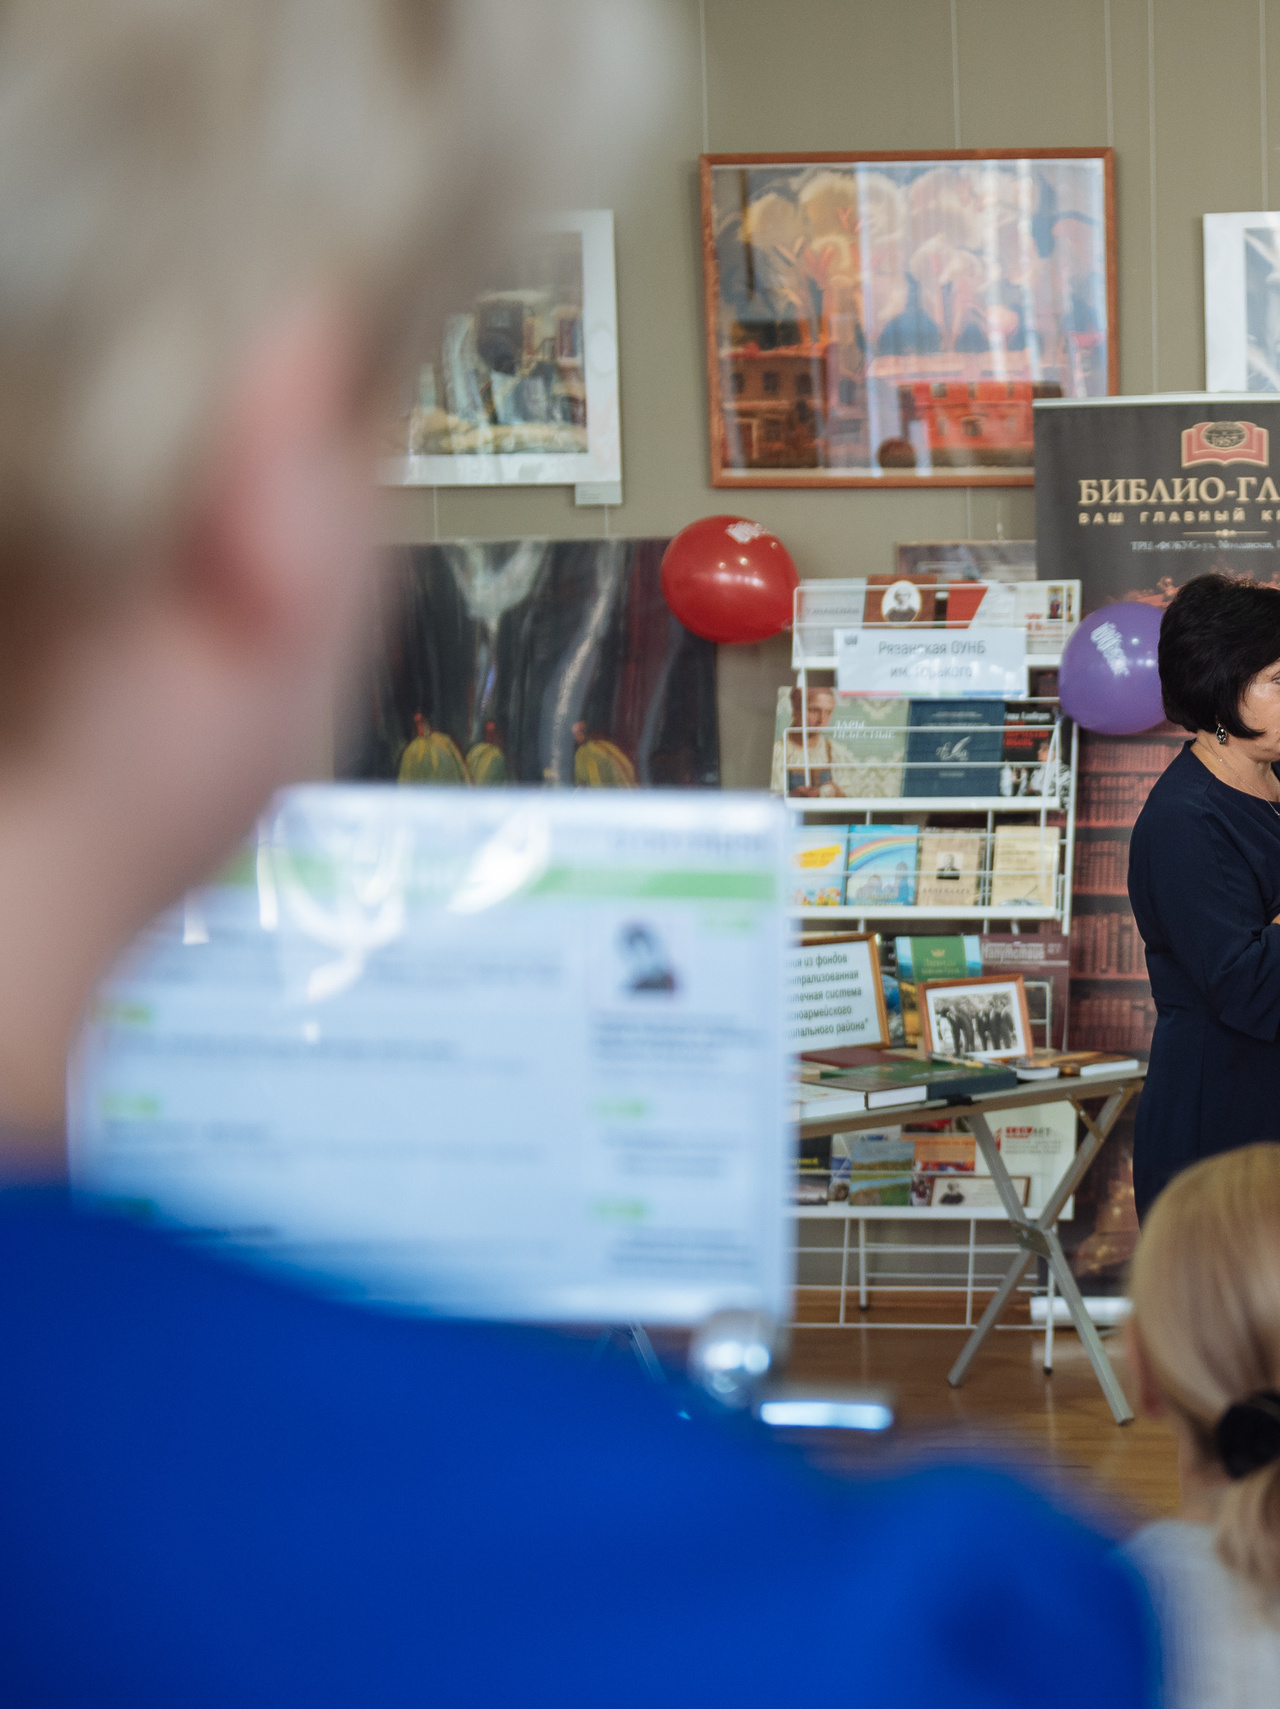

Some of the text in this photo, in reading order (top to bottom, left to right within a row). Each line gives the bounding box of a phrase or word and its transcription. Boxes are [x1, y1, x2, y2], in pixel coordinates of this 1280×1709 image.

[1079, 511, 1124, 525] ВАШ
[1140, 507, 1246, 524] ГЛАВНЫЙ
[878, 640, 986, 655] Рязанская ОУНБ
[890, 666, 911, 678] им.
[804, 956, 814, 967] из
[815, 952, 848, 968] фондов
[825, 986, 862, 1000] система
